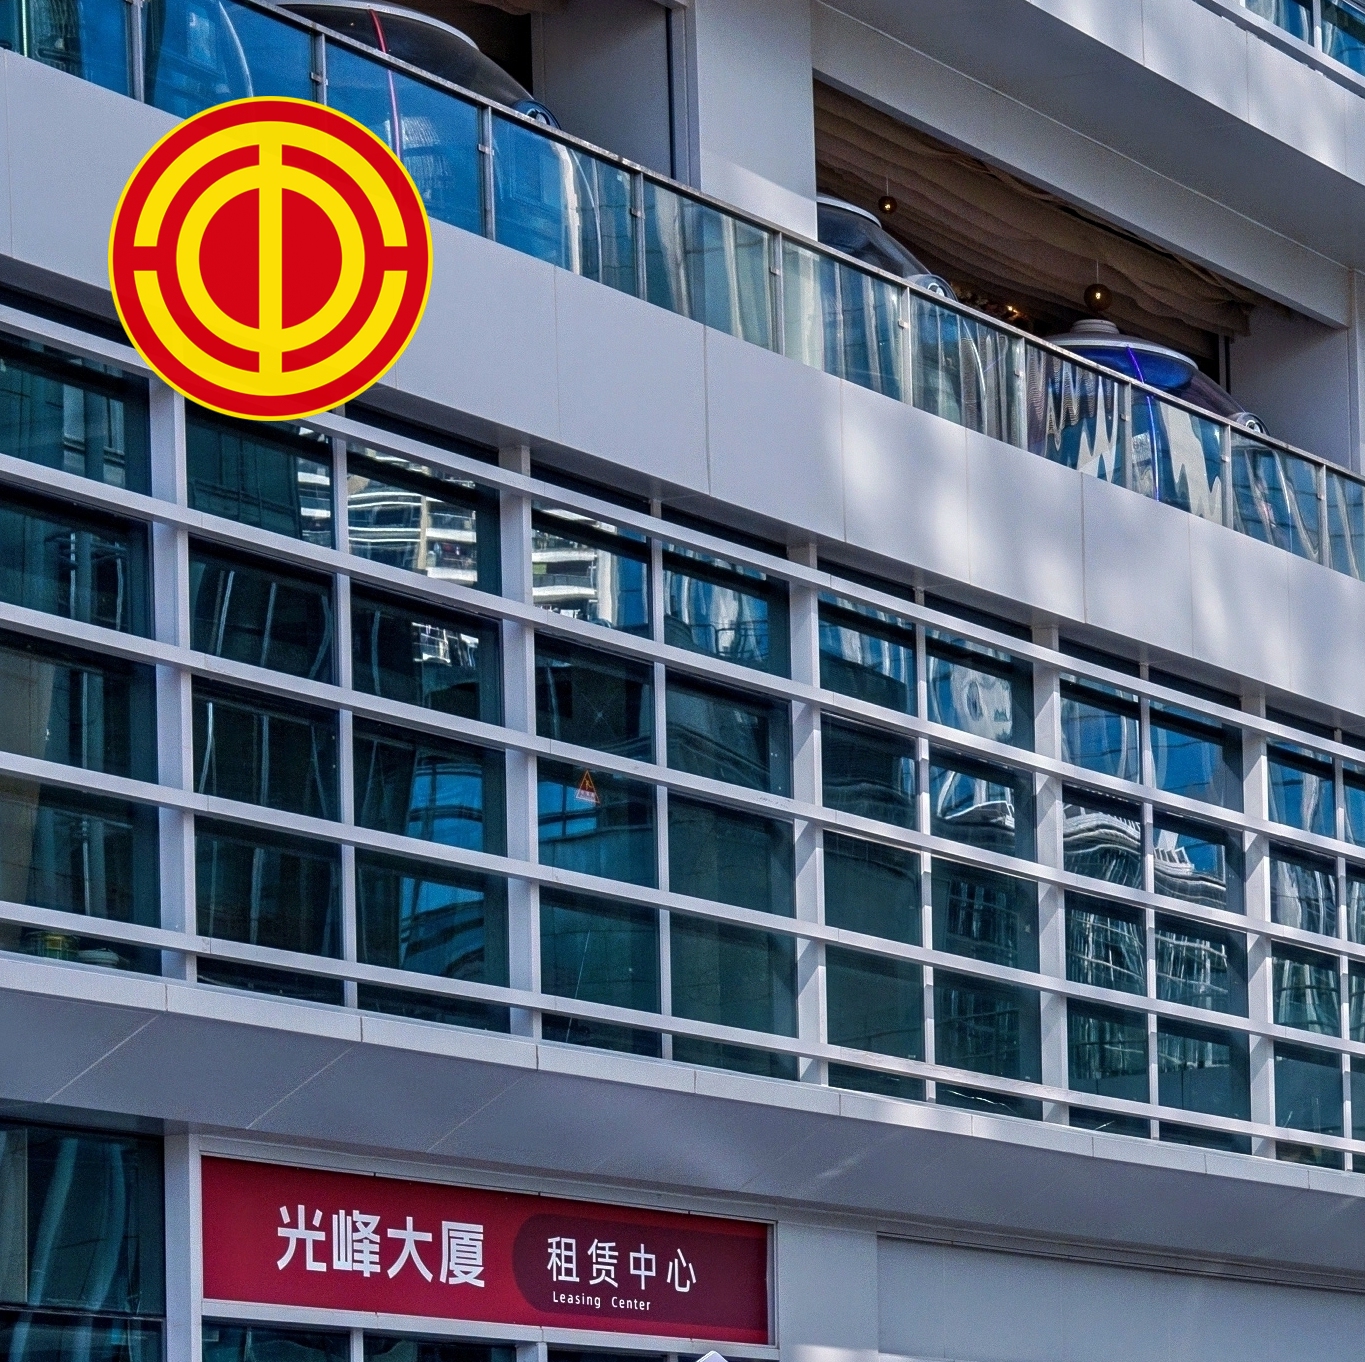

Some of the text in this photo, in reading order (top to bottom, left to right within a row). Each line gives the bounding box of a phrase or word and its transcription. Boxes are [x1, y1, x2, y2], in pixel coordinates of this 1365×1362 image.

[278, 1205, 484, 1288] 光峰大厦
[547, 1236, 696, 1293] 租赁中心
[553, 1291, 650, 1310] Leasing Center
